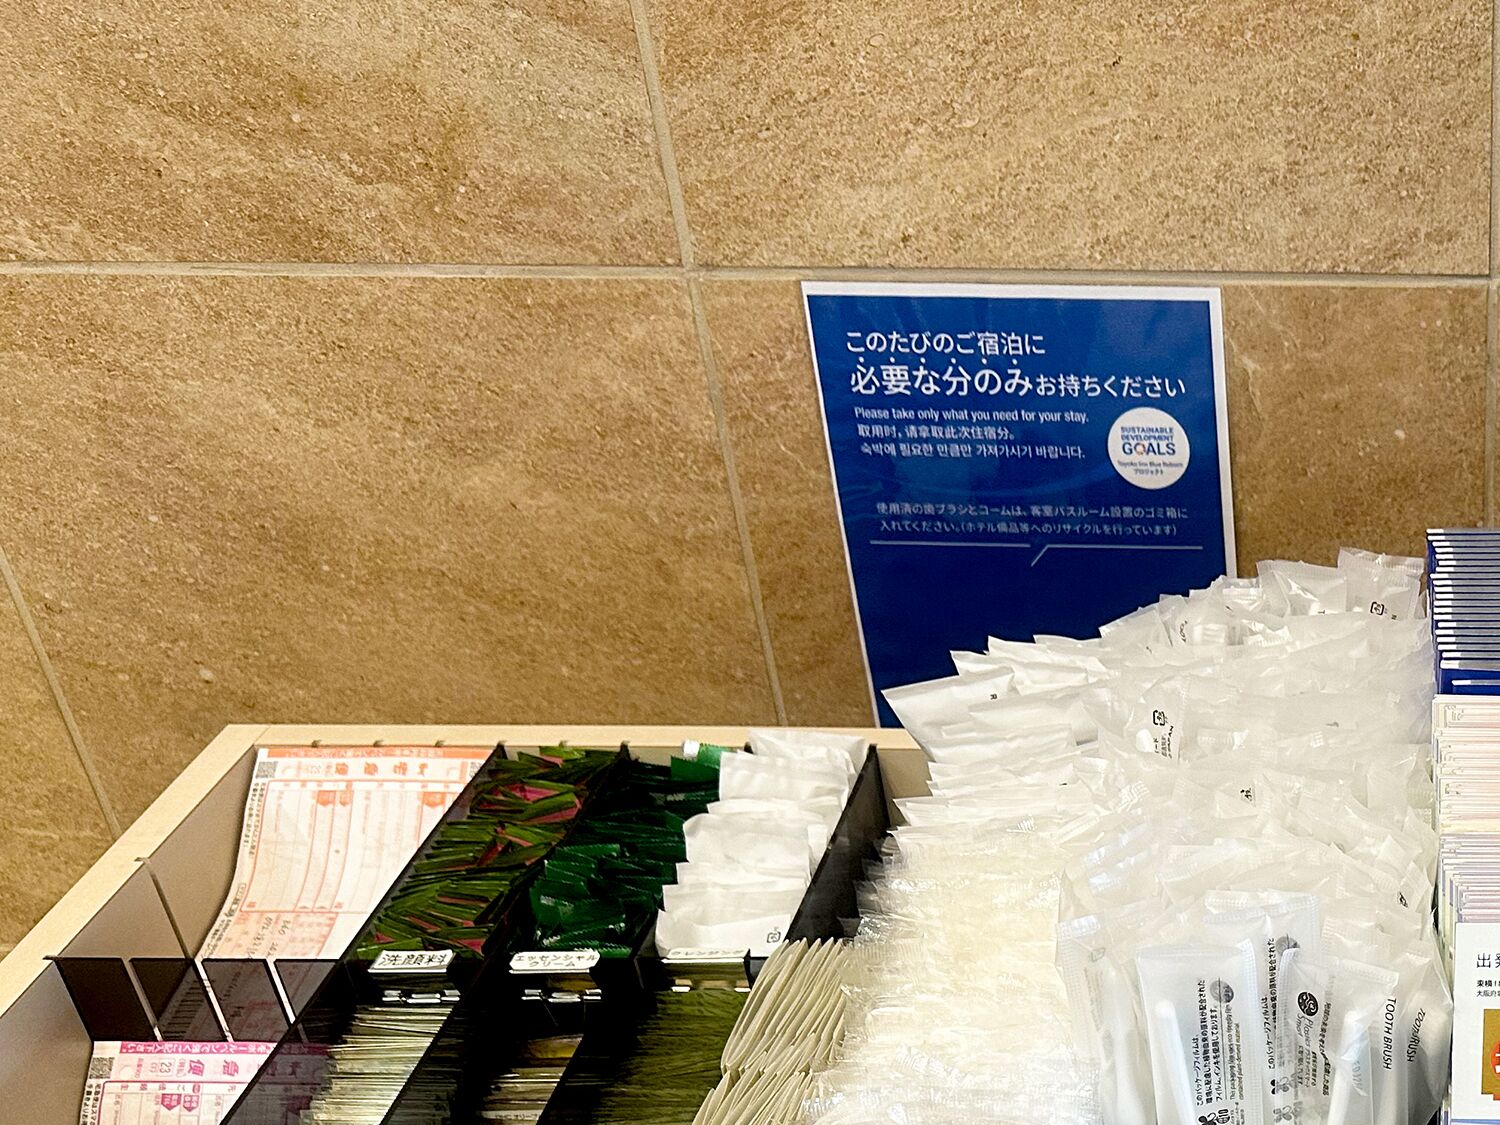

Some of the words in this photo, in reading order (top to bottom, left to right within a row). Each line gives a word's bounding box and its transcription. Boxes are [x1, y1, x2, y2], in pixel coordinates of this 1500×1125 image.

[847, 331, 1046, 356] このたびのご宿泊に
[851, 364, 1186, 398] 必要な分のみお持ちください
[854, 406, 889, 420] Please
[892, 408, 915, 420] take
[918, 408, 939, 422] only
[942, 408, 968, 420] what
[972, 411, 990, 423] you
[993, 410, 1019, 421] need
[1021, 410, 1035, 421] for
[1039, 412, 1061, 424] your
[1064, 410, 1089, 424] stay.
[1120, 426, 1174, 434] SUSTAINABLE
[861, 443, 896, 456] 숙박에
[899, 443, 933, 457] 필요한
[937, 443, 972, 458] 만큼만
[976, 445, 1032, 459] 가져가시기
[1037, 446, 1085, 459] 바랍니다.
[1122, 442, 1176, 456] GOALS
[378, 953, 448, 967] 洗顔料
[514, 952, 598, 964] エッセンシャル
[527, 960, 577, 968] クリーム
[1383, 998, 1397, 1035] TOOTH
[1382, 1036, 1393, 1070] BRUSH
